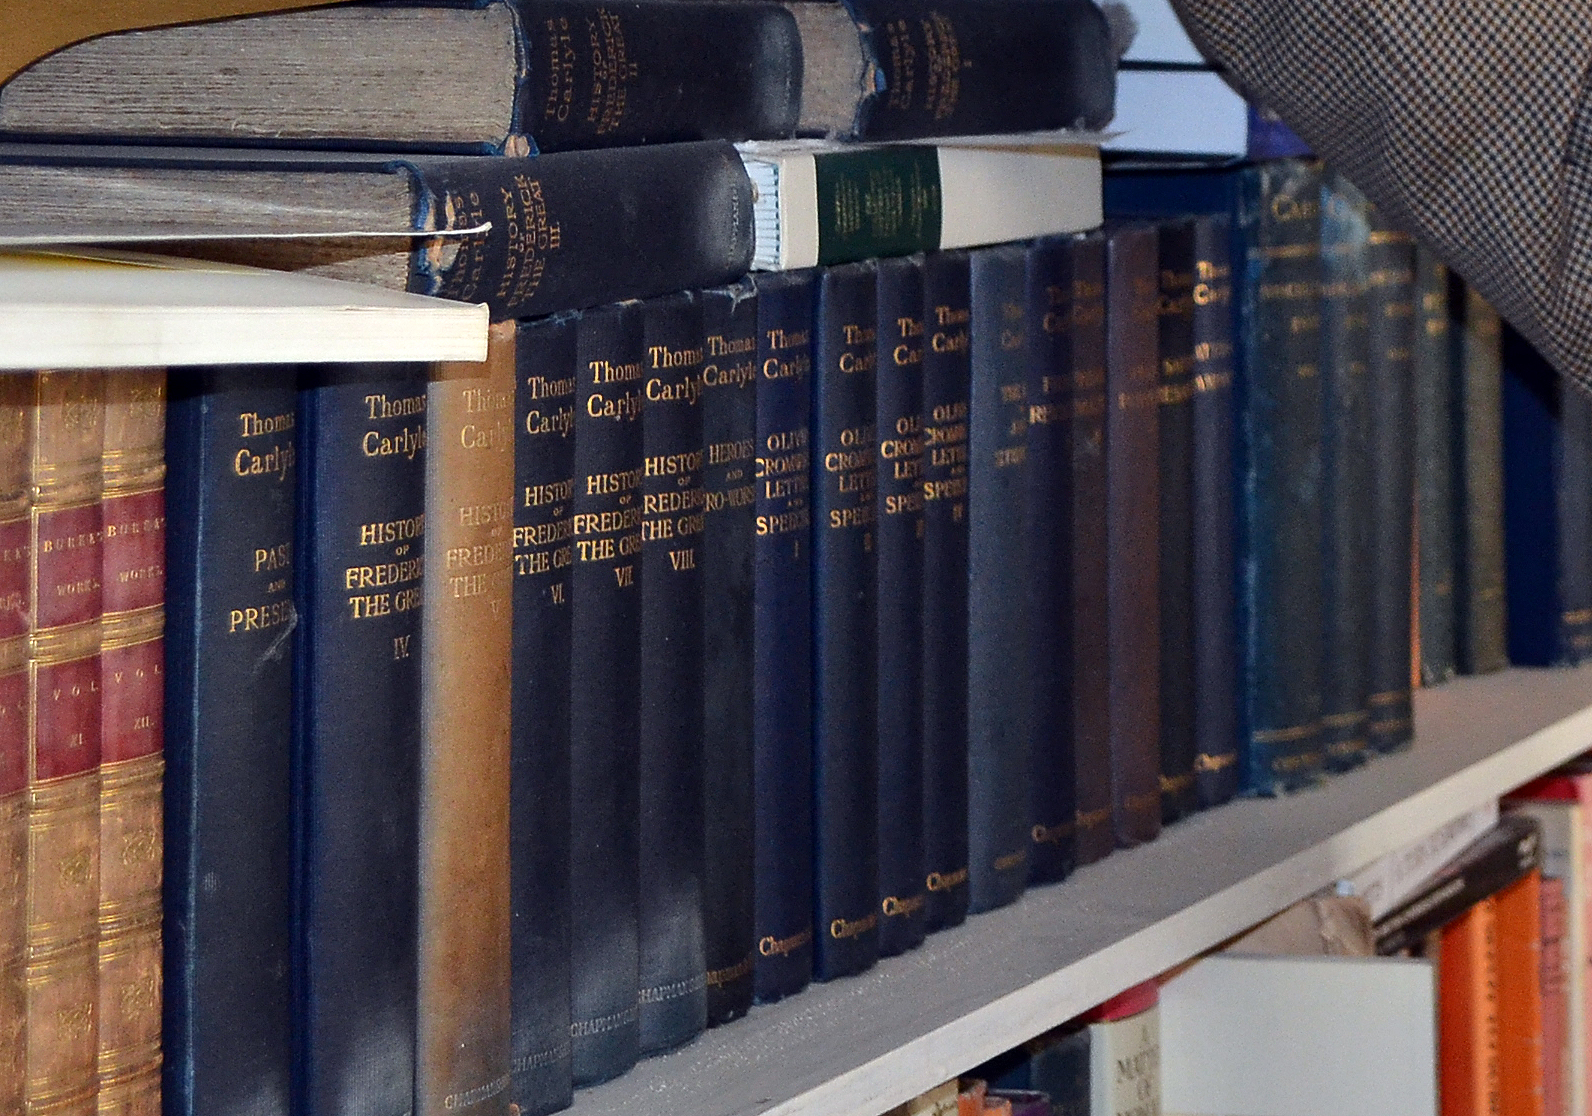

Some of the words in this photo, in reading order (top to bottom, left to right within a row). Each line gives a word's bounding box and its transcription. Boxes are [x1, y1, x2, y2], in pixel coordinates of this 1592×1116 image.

[557, 16, 577, 123] Carlyle
[528, 176, 548, 250] GREAT
[497, 186, 518, 299] HISTORY
[507, 172, 537, 308] FREDERICK
[521, 258, 546, 302] THE
[589, 360, 643, 384] Thom
[648, 346, 703, 369] Thom
[527, 376, 575, 400] Thom
[645, 375, 703, 405] Carly
[587, 389, 643, 421] Carly
[525, 405, 575, 438] Carly
[362, 424, 427, 461] Carlyl
[709, 439, 755, 465] HEROES
[767, 427, 809, 451] OLIV
[644, 449, 703, 477] HISTO
[524, 478, 575, 507] HISTO
[587, 466, 644, 495] HISTO
[618, 494, 632, 506] OF
[360, 513, 425, 547] HISTOR
[513, 519, 573, 548] FREDER
[573, 507, 643, 536] FREDER
[677, 513, 704, 537] GRE
[395, 543, 410, 557] OF
[515, 551, 550, 576] THE
[553, 545, 572, 570] GRE
[576, 539, 615, 562] THE
[618, 533, 643, 557] GRE
[345, 555, 423, 590] FREDER
[229, 599, 295, 634] PRESE
[348, 592, 391, 619] THE
[394, 586, 424, 613] GRE
